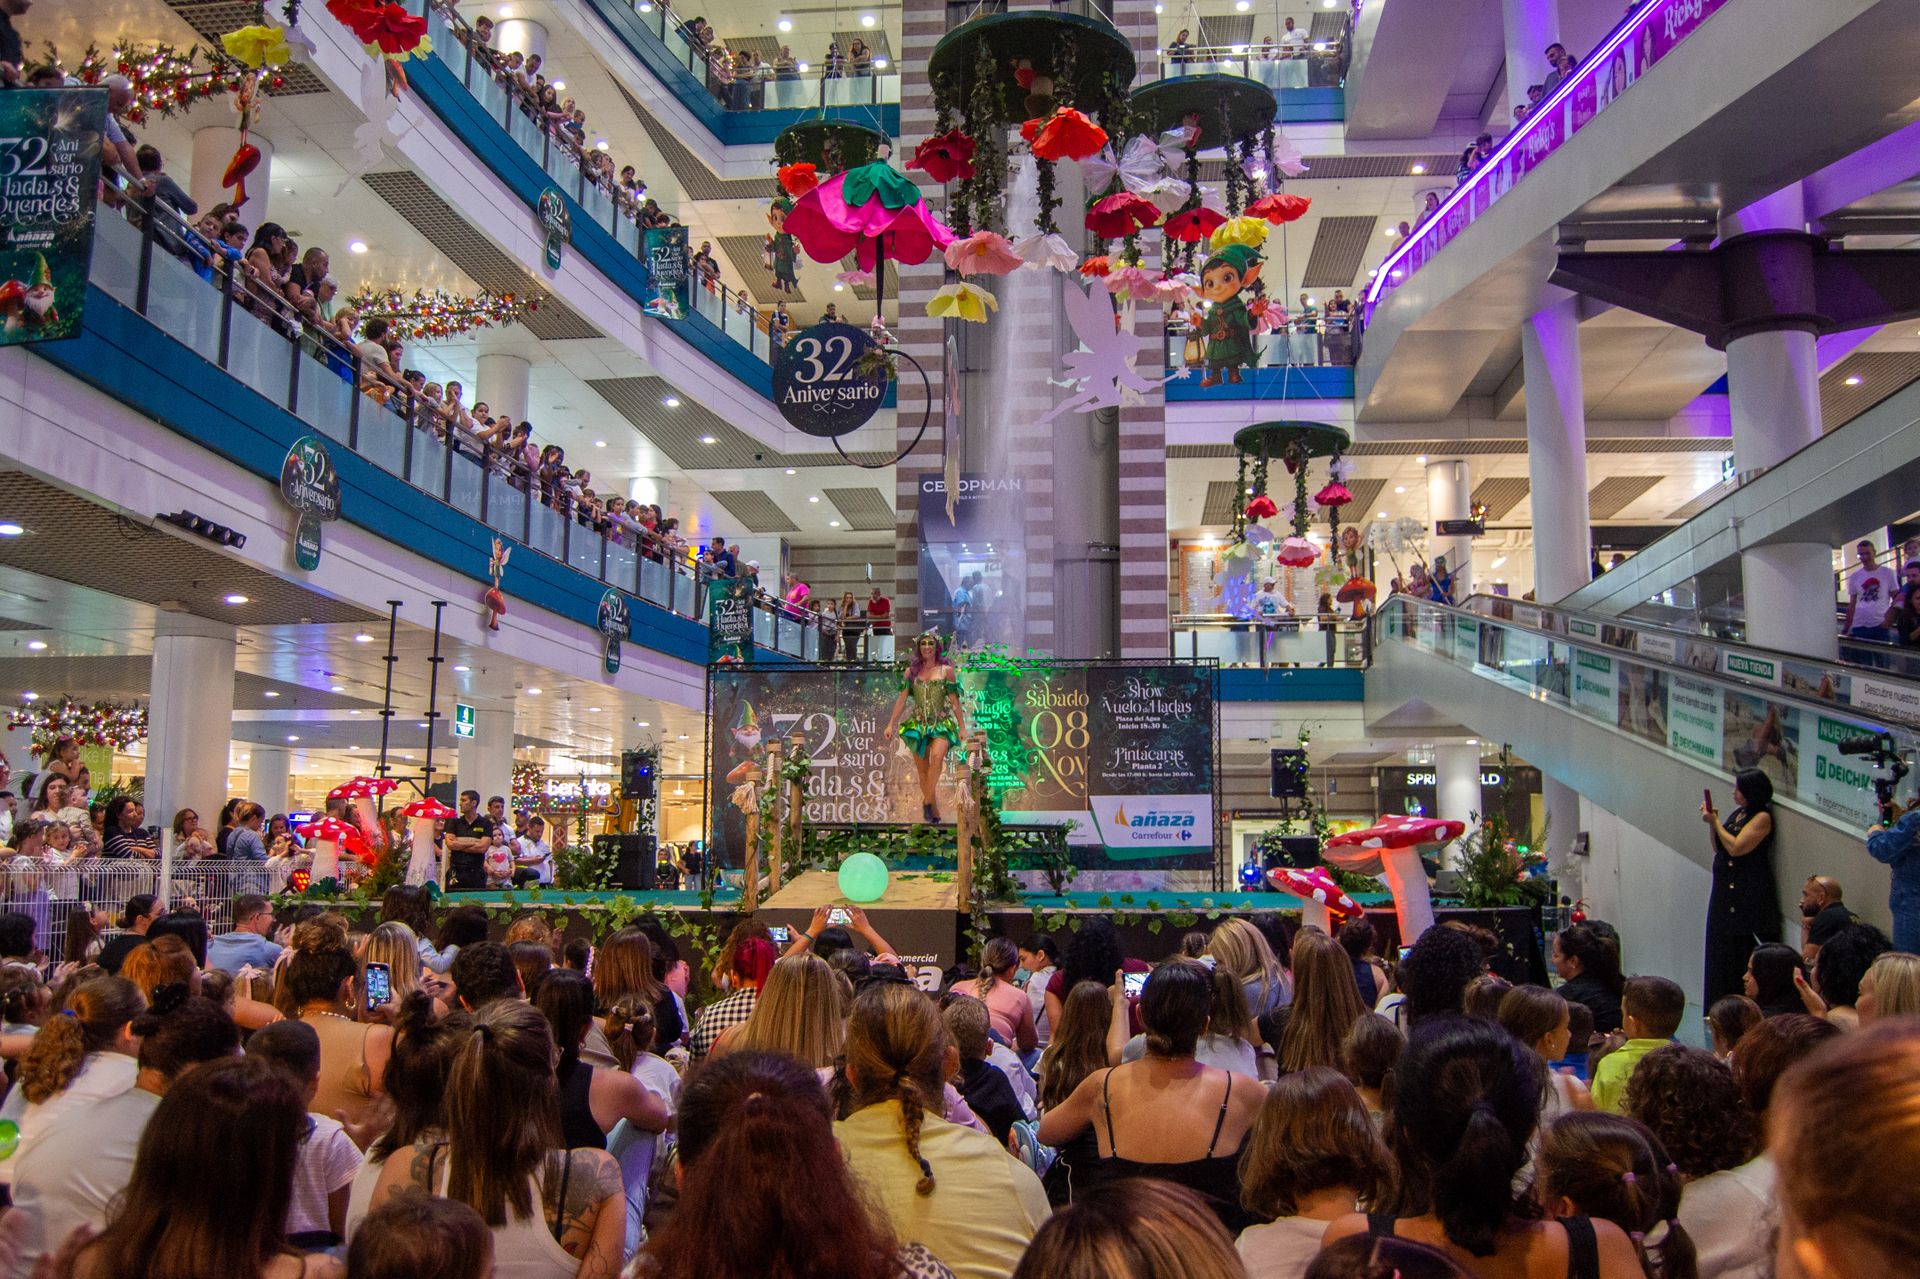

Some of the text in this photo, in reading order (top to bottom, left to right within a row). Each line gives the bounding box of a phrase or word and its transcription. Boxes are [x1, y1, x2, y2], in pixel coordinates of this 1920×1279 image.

[1663, 0, 1710, 40] Ricky
[53, 153, 76, 163] ver
[66, 176, 80, 195] &
[651, 246, 671, 262] 32
[795, 335, 854, 383] 32
[303, 444, 326, 491] 32
[290, 479, 335, 511] Aniversario
[922, 479, 1021, 493] CEOPMAN
[610, 594, 623, 622] 32
[715, 598, 735, 615] 32
[1730, 656, 1773, 678] NUEVA TIENDA
[1025, 679, 1090, 710] Sábado
[1128, 679, 1165, 699] Show
[1864, 683, 1894, 700] Descubre
[972, 700, 1011, 719] Magic
[1102, 698, 1142, 714] Vuelo
[840, 717, 876, 739] Ani
[1030, 710, 1091, 749] 08
[1118, 722, 1139, 730] Inicio
[1162, 722, 1171, 730] h.
[845, 736, 874, 751] ver
[839, 750, 886, 769] sario
[866, 769, 886, 799] &
[1407, 773, 1501, 786] SPRILD
[1828, 762, 1871, 790] DEICHM
[1130, 811, 1195, 827] añaza
[1131, 831, 1174, 840] Carrefour
[898, 953, 938, 963] omercial
